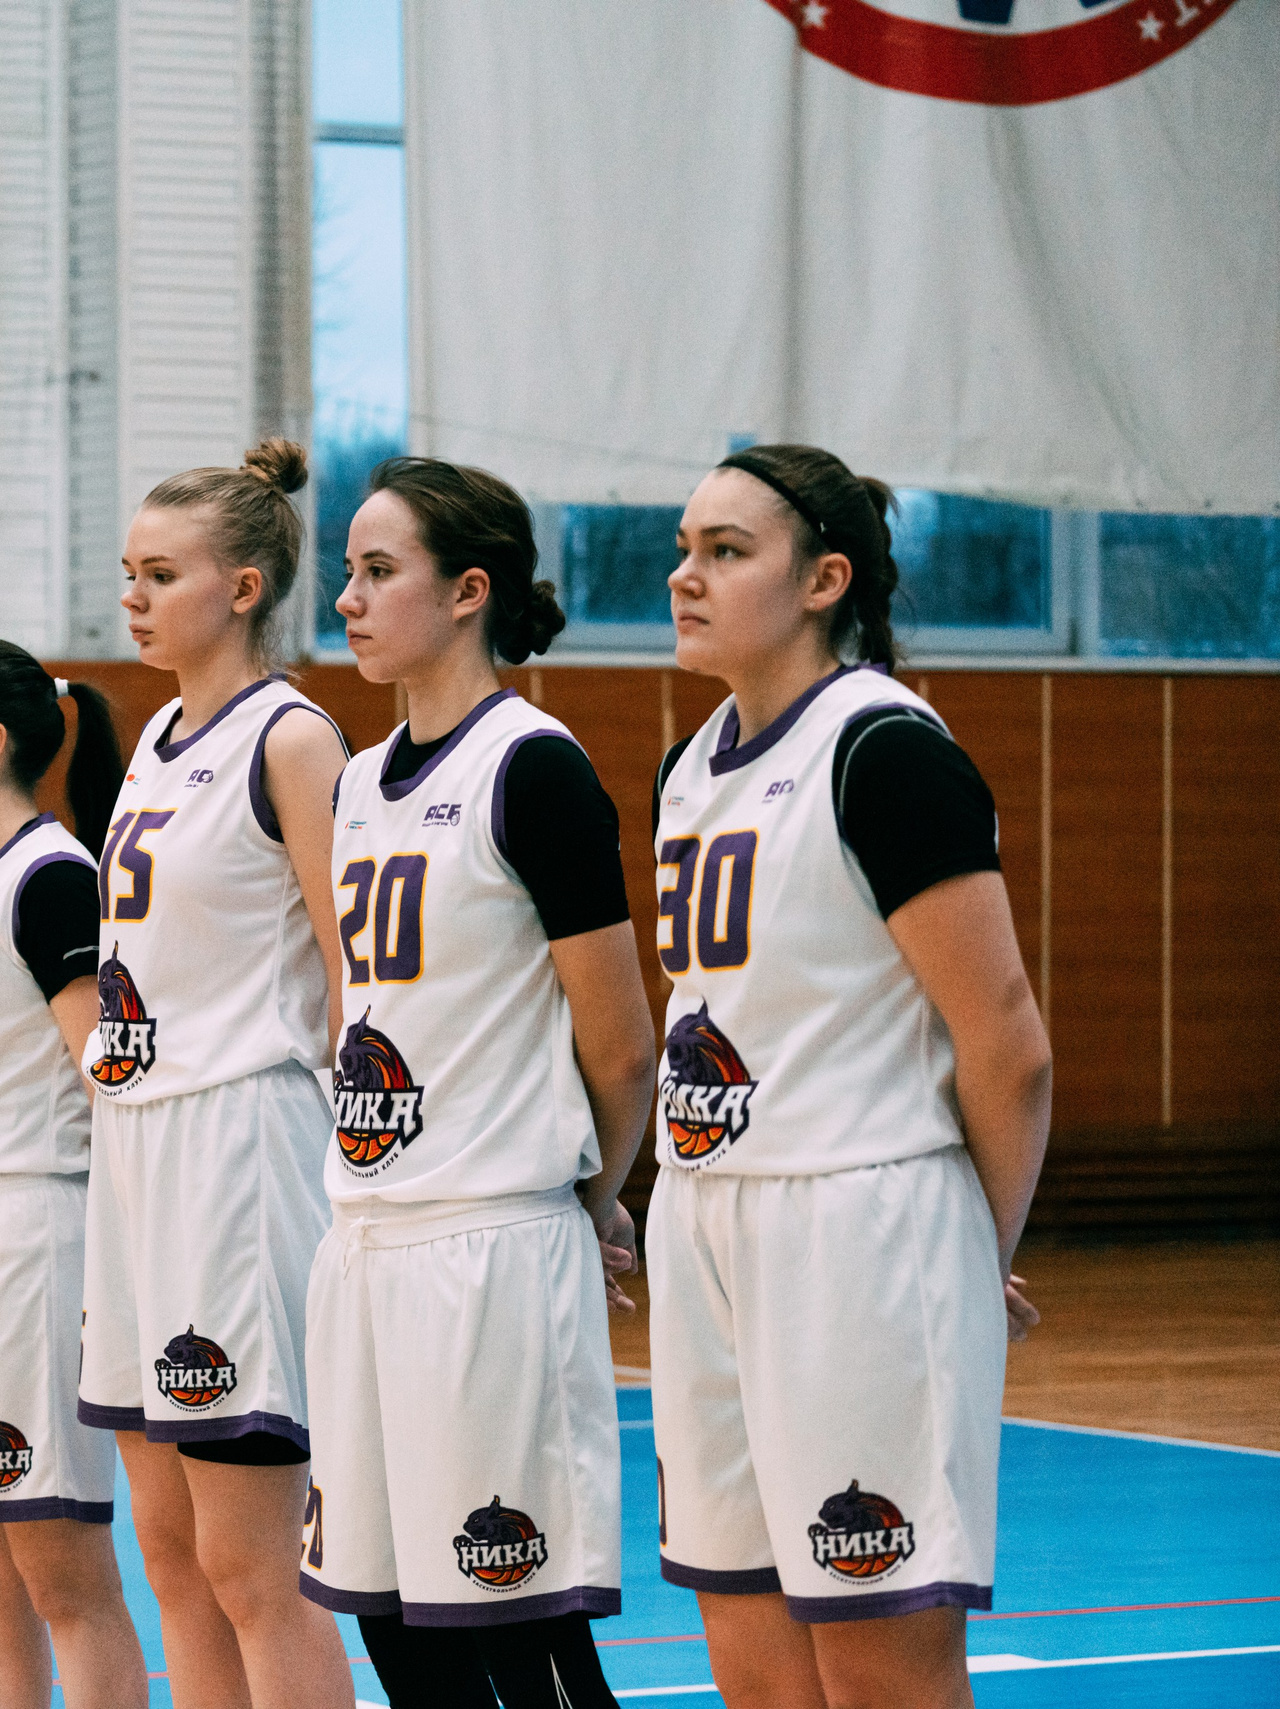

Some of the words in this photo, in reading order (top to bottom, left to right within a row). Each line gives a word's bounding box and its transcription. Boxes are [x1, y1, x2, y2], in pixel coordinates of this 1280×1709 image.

[99, 808, 178, 923] 15
[337, 851, 429, 988] 20
[657, 827, 759, 976] 30
[160, 1366, 234, 1392] НИКА
[460, 1537, 545, 1573] НИКА
[815, 1526, 911, 1563] НИКА
[472, 1580, 522, 1593] БАСКЕТБОЛЬНЫЙ
